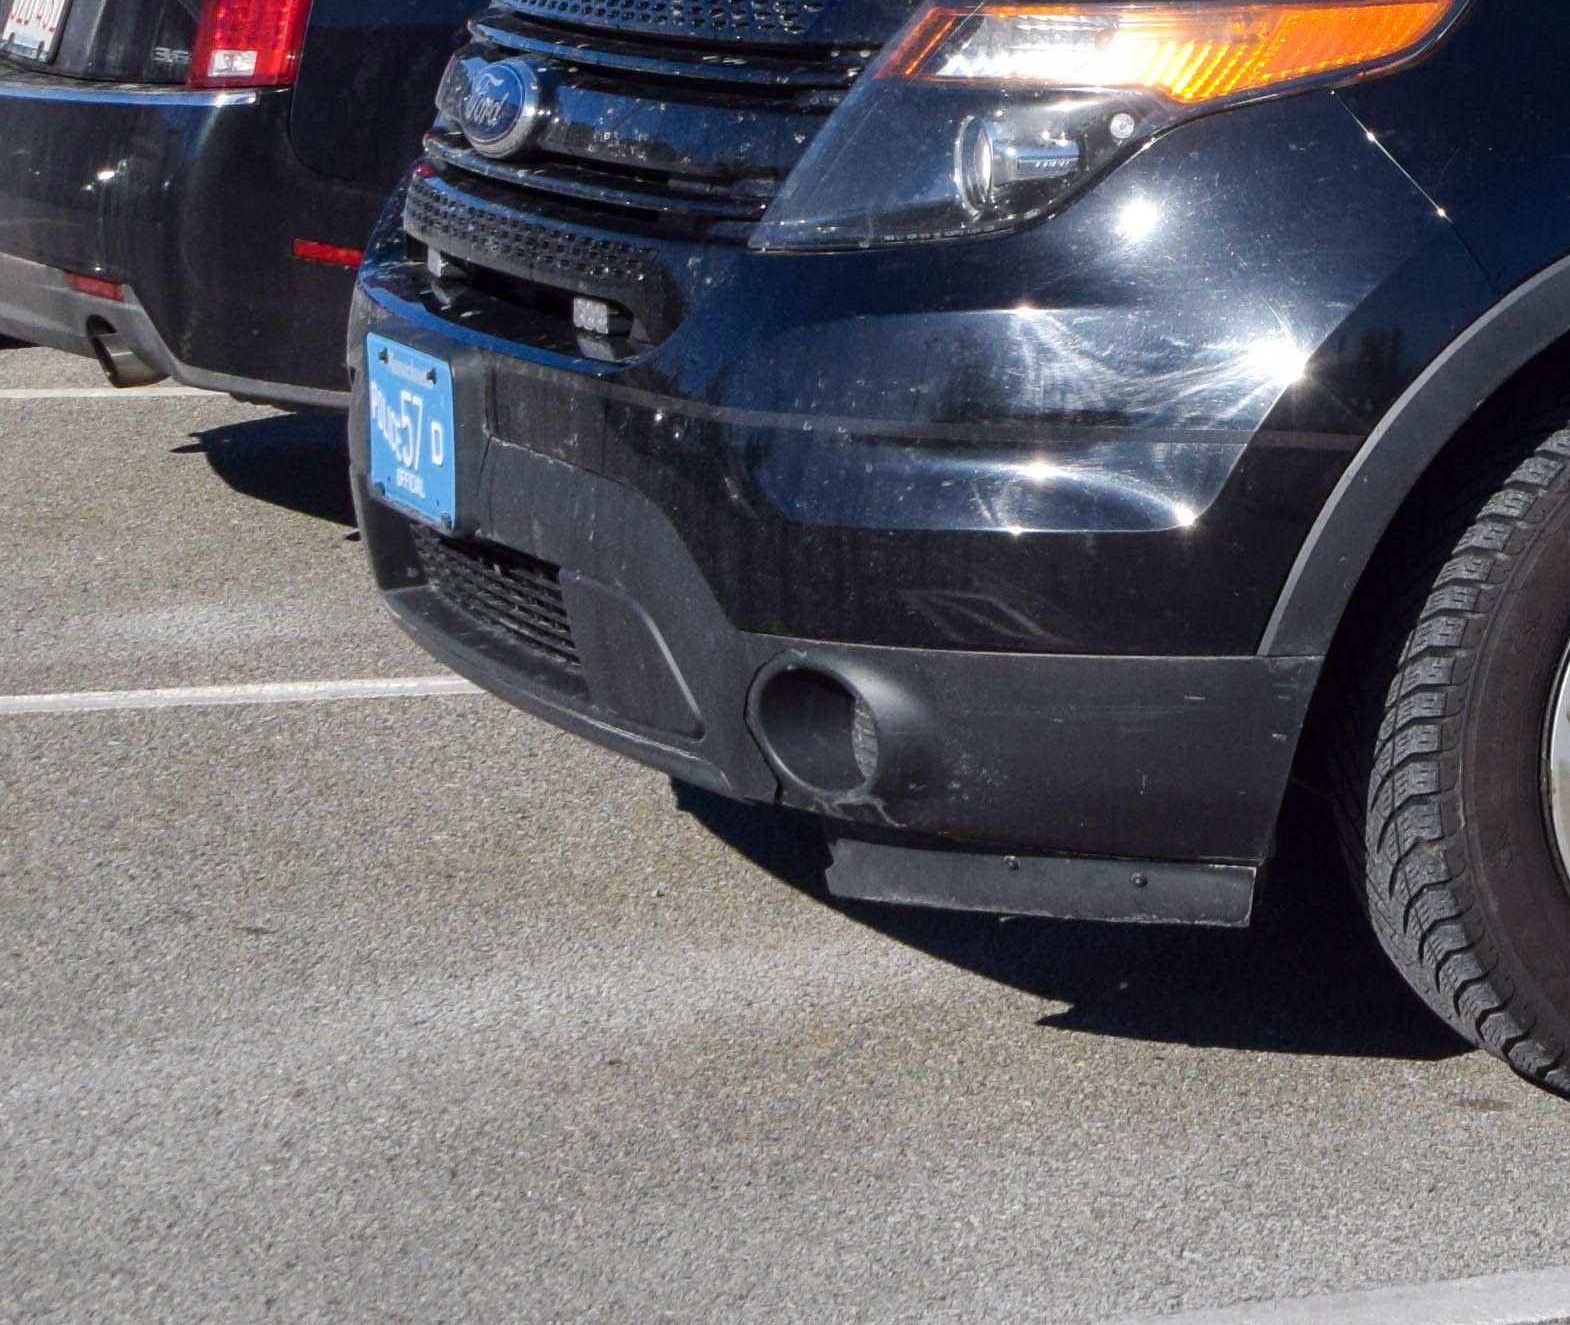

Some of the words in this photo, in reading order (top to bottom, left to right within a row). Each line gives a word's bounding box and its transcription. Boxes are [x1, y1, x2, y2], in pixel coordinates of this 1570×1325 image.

[465, 72, 510, 127] Ford
[369, 380, 402, 461] POLICE
[401, 389, 424, 471] 57
